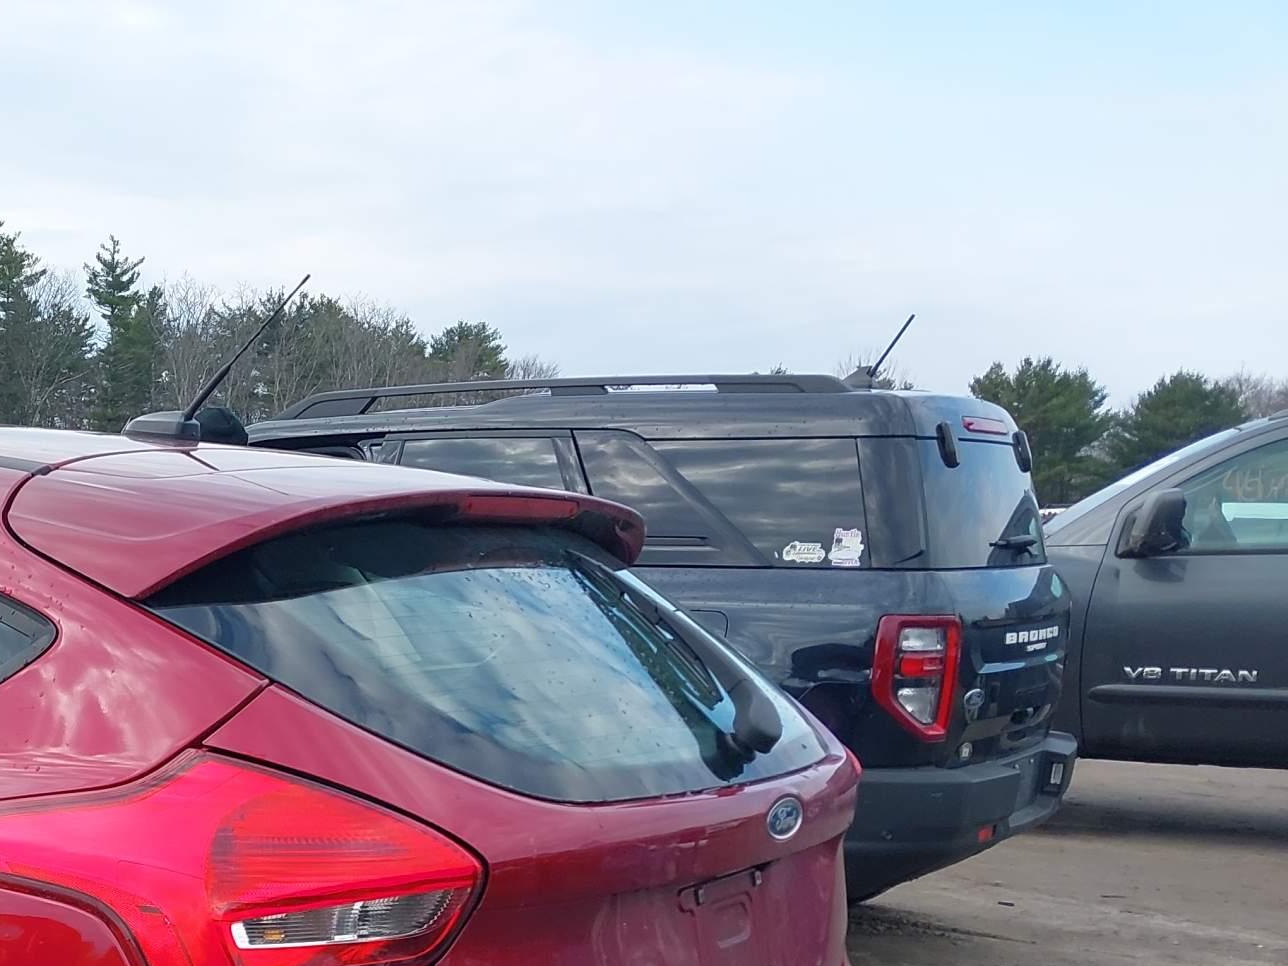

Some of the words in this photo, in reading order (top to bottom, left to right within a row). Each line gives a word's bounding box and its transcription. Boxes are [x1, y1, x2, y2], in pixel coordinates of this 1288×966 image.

[1005, 625, 1059, 645] BRONCO
[1123, 666, 1162, 680] V8
[1169, 667, 1259, 682] TITAN
